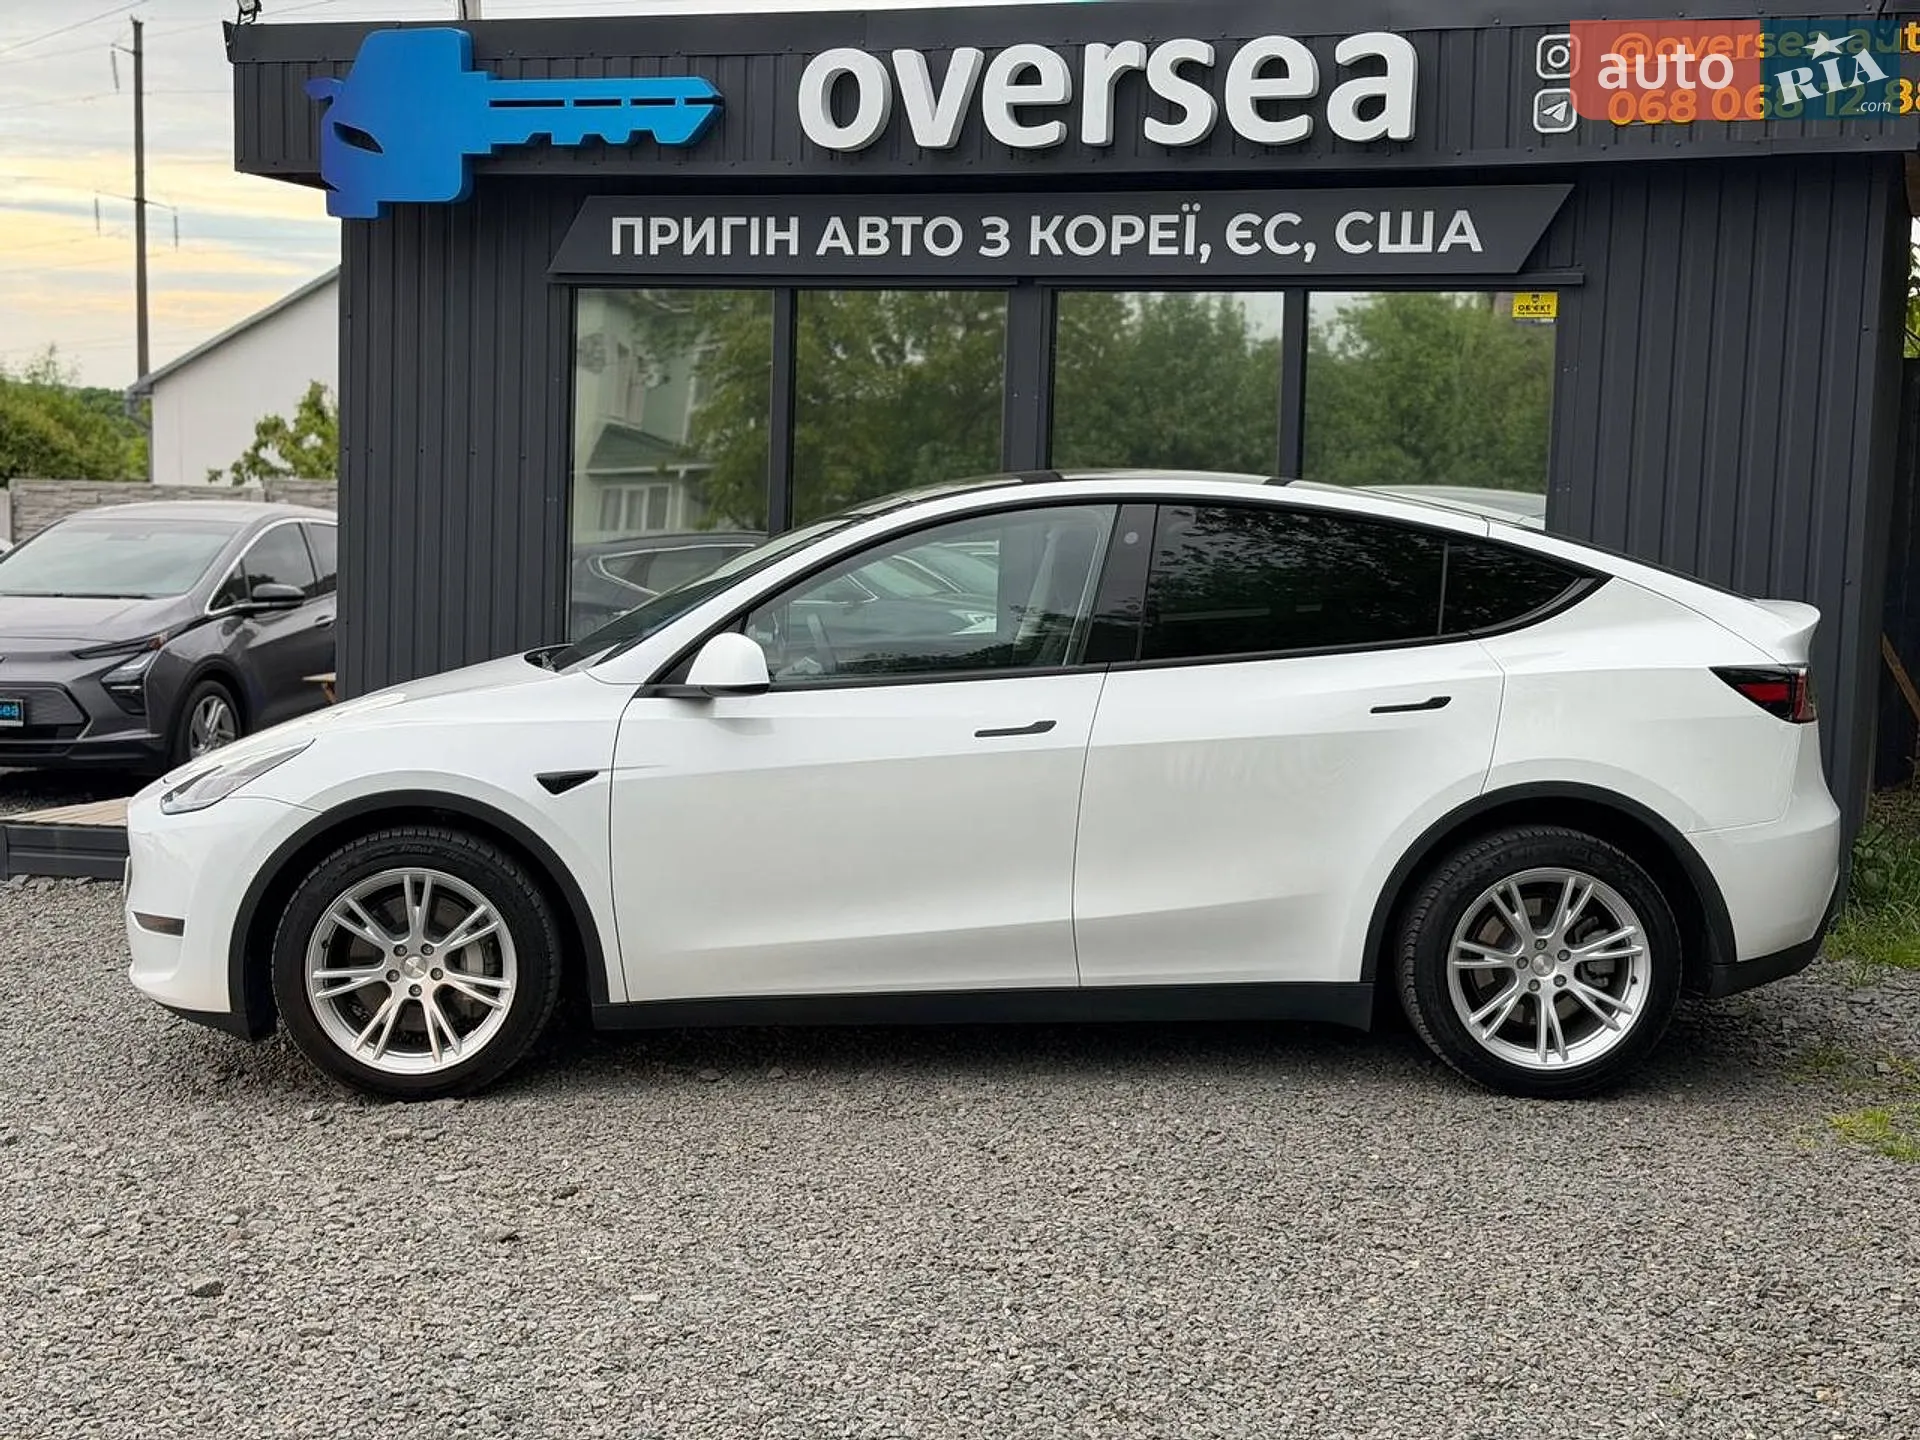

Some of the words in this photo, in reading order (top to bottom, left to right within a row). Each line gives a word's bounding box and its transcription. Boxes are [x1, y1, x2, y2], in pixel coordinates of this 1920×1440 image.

[798, 31, 1418, 152] oversea
[1608, 89, 1697, 125] 068
[1884, 78, 1920, 114] 8
[611, 217, 799, 255] ПРИГІН
[815, 216, 963, 257] АВТО
[978, 216, 1010, 257] З
[1030, 203, 1212, 263] КОРЕЇ,
[1225, 212, 1316, 263] ЄС,
[1335, 210, 1483, 254] США
